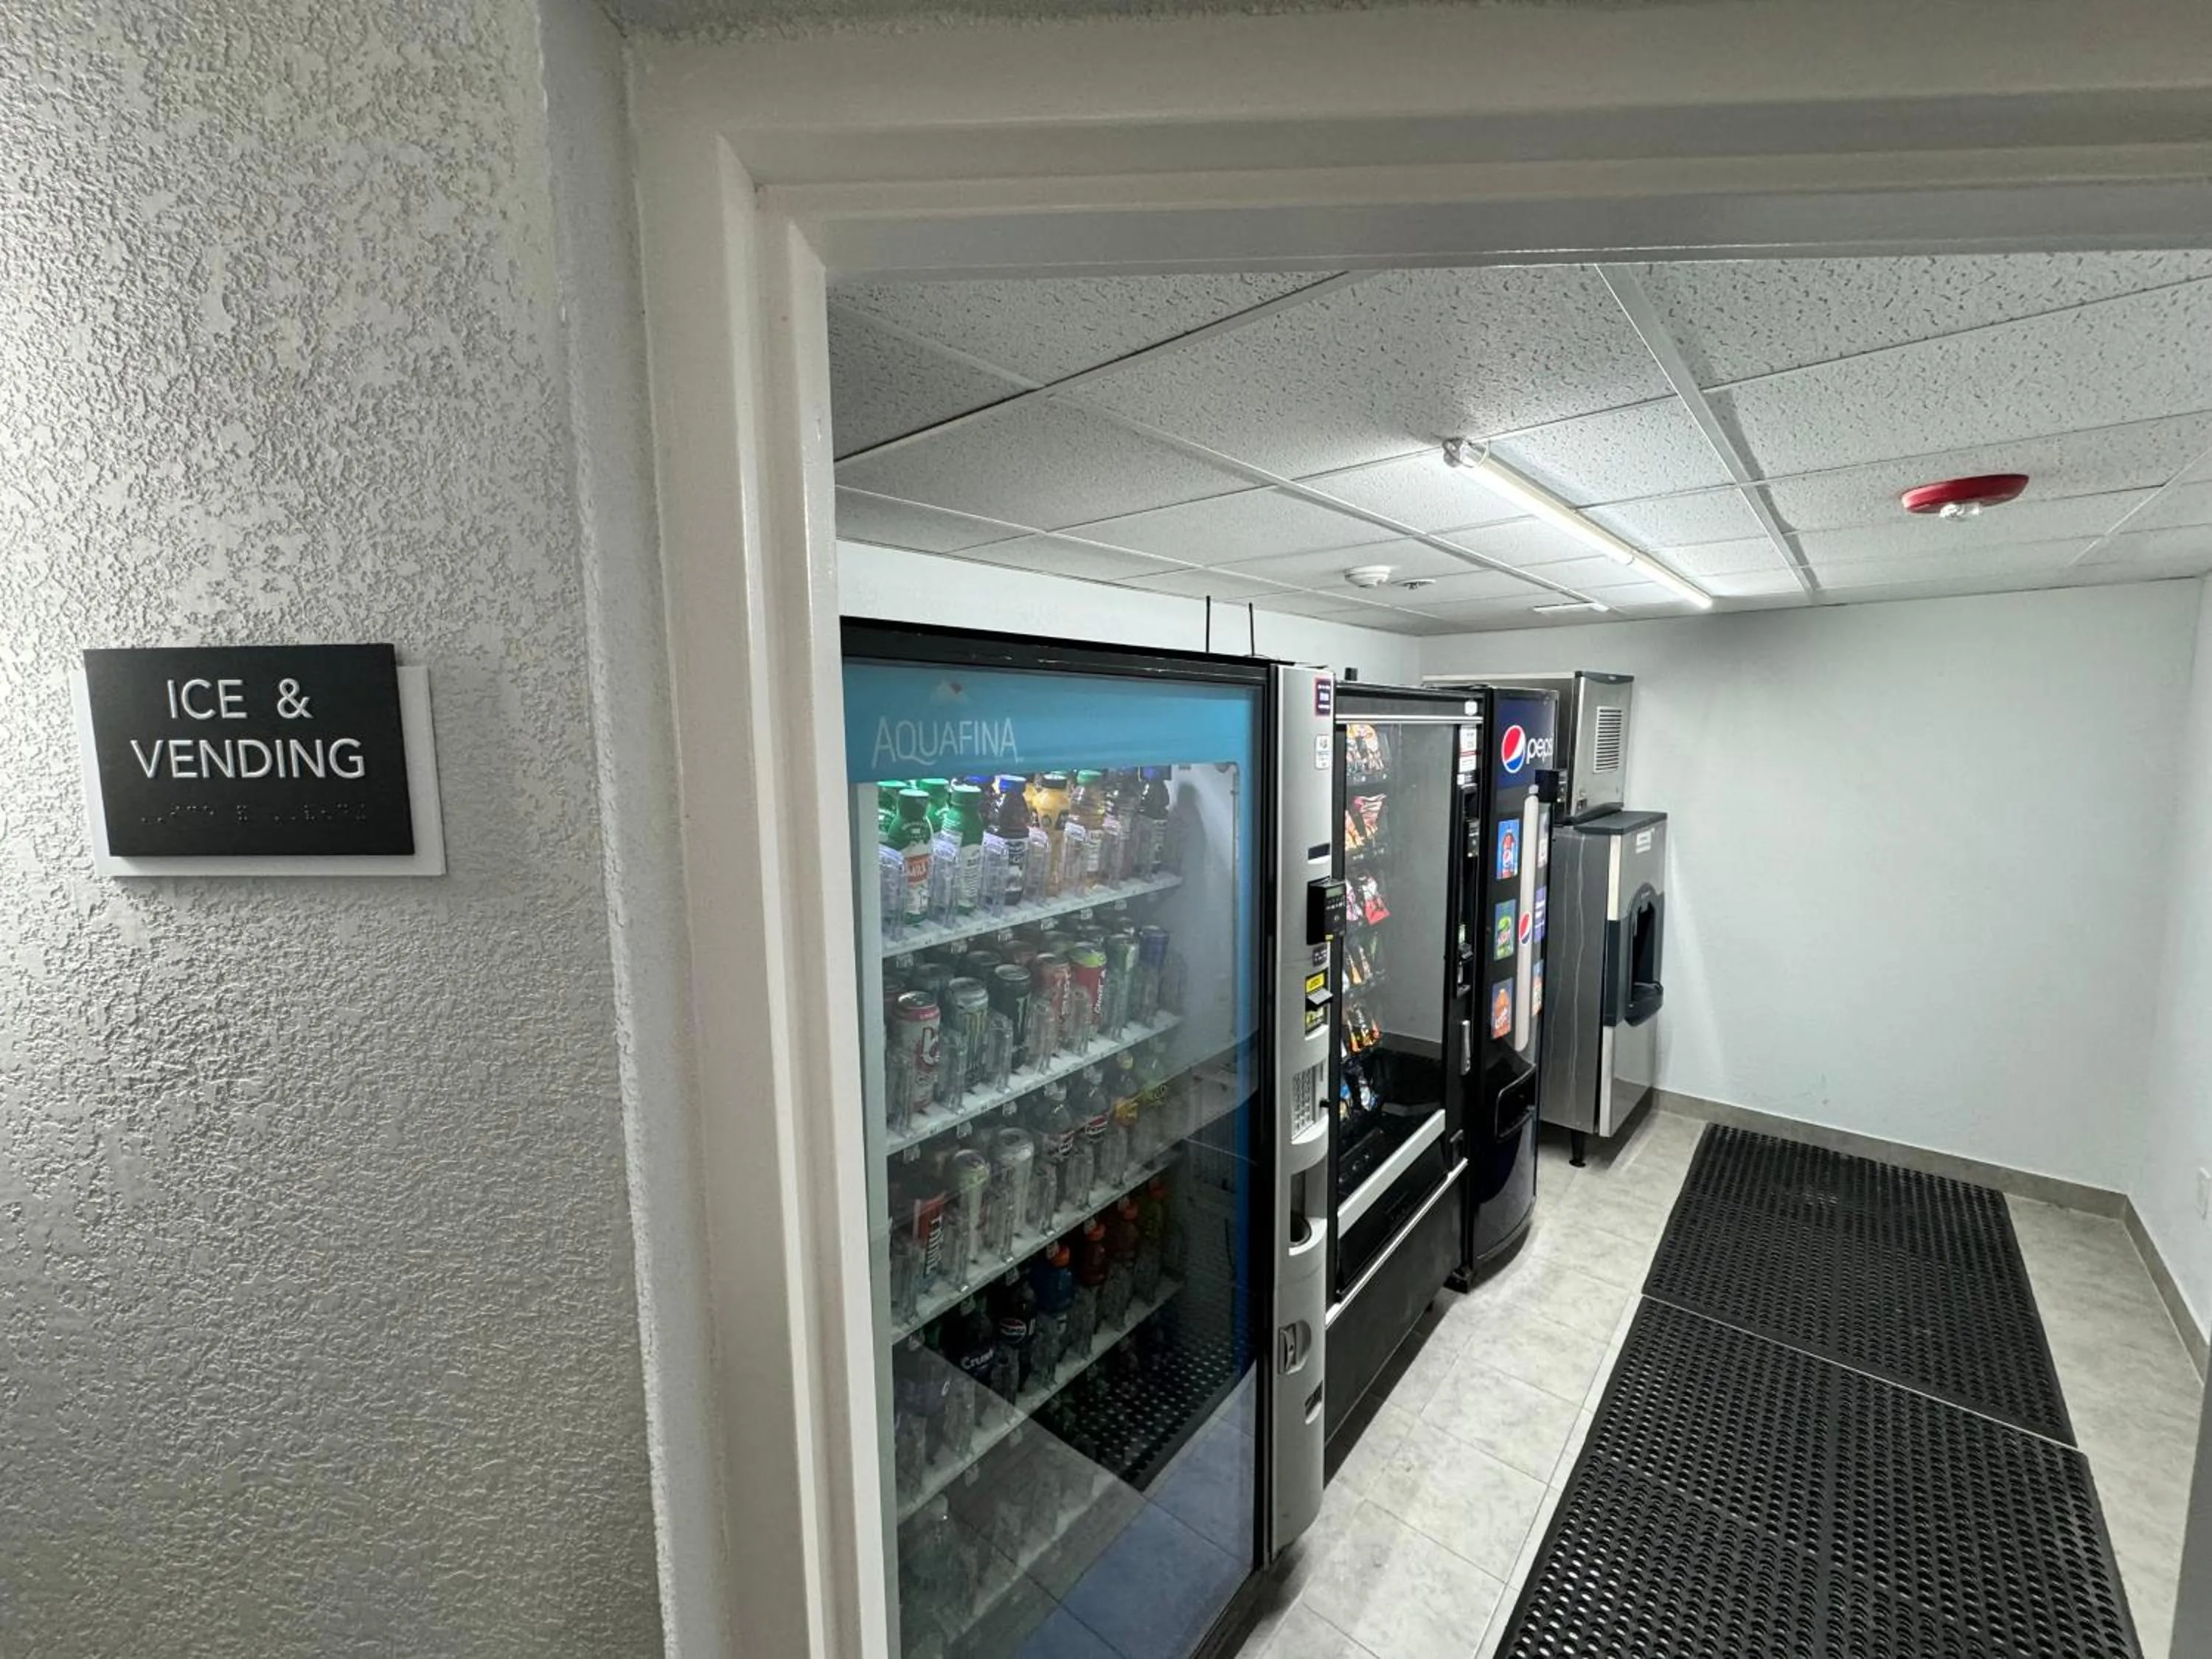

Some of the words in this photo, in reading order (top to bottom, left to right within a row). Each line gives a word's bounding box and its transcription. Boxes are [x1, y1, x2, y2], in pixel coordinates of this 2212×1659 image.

[167, 678, 248, 720] ICE
[276, 678, 314, 719] &
[130, 738, 366, 779] VENDING
[872, 716, 1019, 770] AQUAFINA
